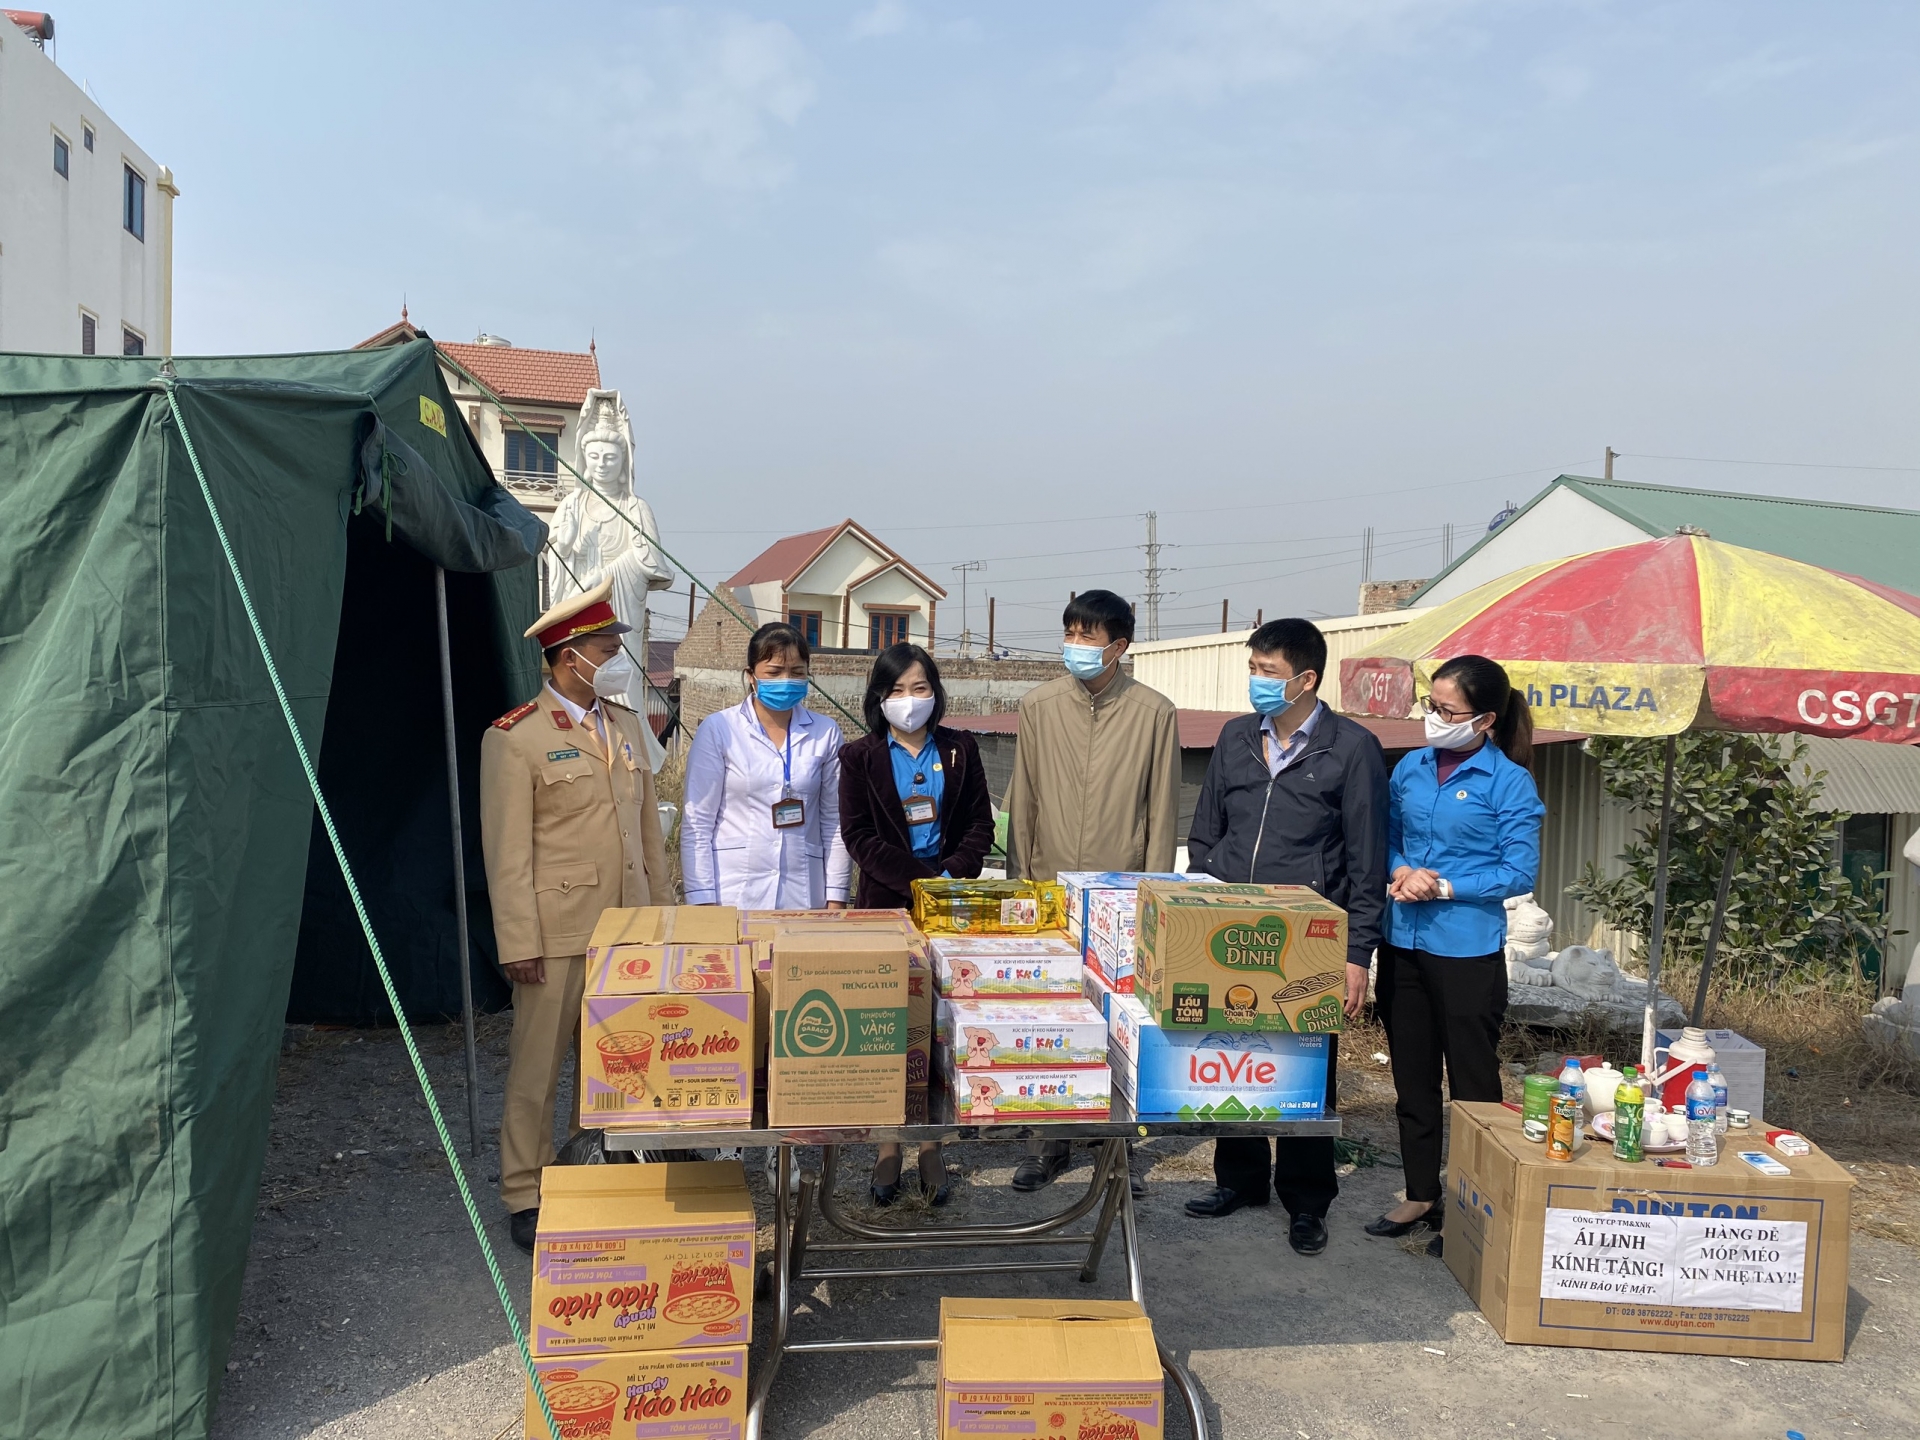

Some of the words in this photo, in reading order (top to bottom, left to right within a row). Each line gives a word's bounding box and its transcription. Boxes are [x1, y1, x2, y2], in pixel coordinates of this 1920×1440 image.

[1361, 672, 1393, 702] CSGT
[1549, 684, 1658, 712] PLAZA
[1797, 689, 1920, 728] CSGT
[1223, 928, 1280, 947] CUNG
[1225, 946, 1277, 966] ĐÌNH
[878, 964, 891, 974] 20
[1179, 995, 1200, 1007] LẨU
[1176, 1006, 1203, 1017] TÔM
[1224, 1009, 1244, 1017] Khoai
[1302, 1003, 1337, 1021] CUNG
[662, 1022, 669, 1030] MÌ
[801, 1025, 829, 1034] DABACO
[860, 1019, 896, 1036] VÀNG
[661, 1027, 694, 1043] Handy
[660, 1037, 699, 1061] Hảo
[701, 1030, 740, 1056] Hảo
[1189, 1051, 1277, 1084] laVie
[1572, 1215, 1594, 1224] CÔNG
[1618, 1220, 1651, 1229] TM&XNK
[1574, 1227, 1594, 1246] ÁI
[1600, 1233, 1646, 1250] LINH
[1705, 1224, 1753, 1241] HÀNG
[1758, 1226, 1779, 1242] DỄ
[559, 1243, 567, 1251] 67
[583, 1242, 593, 1251] (24
[595, 1241, 603, 1249] kg
[1700, 1245, 1738, 1261] MÓP
[1742, 1246, 1780, 1262] MÉO
[1551, 1252, 1600, 1273] KÍNH
[1606, 1256, 1664, 1279] TẶNG!
[1680, 1267, 1709, 1280] XIN
[1713, 1269, 1749, 1285] NHẸ
[1753, 1271, 1797, 1284] TAY!!
[1589, 1280, 1612, 1292] BẢO
[1615, 1283, 1628, 1294] VỆ
[606, 1282, 659, 1316] Hảo
[548, 1291, 602, 1326] Hảo
[1606, 1307, 1619, 1315] ĐT:
[1621, 1308, 1635, 1316] 028
[1637, 1309, 1673, 1318] 38762222
[1680, 1312, 1696, 1320] Fax:
[1699, 1313, 1712, 1321] 028
[1714, 1313, 1750, 1322] 38762225
[614, 1306, 657, 1328] Handy
[1640, 1317, 1715, 1329] www.duytan.com
[637, 1323, 645, 1331] LY
[647, 1323, 656, 1331] MÌ
[627, 1374, 636, 1382] MÌ
[626, 1376, 669, 1398] Handy
[623, 1388, 677, 1423] Hảo
[680, 1378, 732, 1412] Hảo
[969, 1394, 977, 1402] 67
[992, 1394, 1002, 1402] (24
[1004, 1394, 1012, 1402] kg
